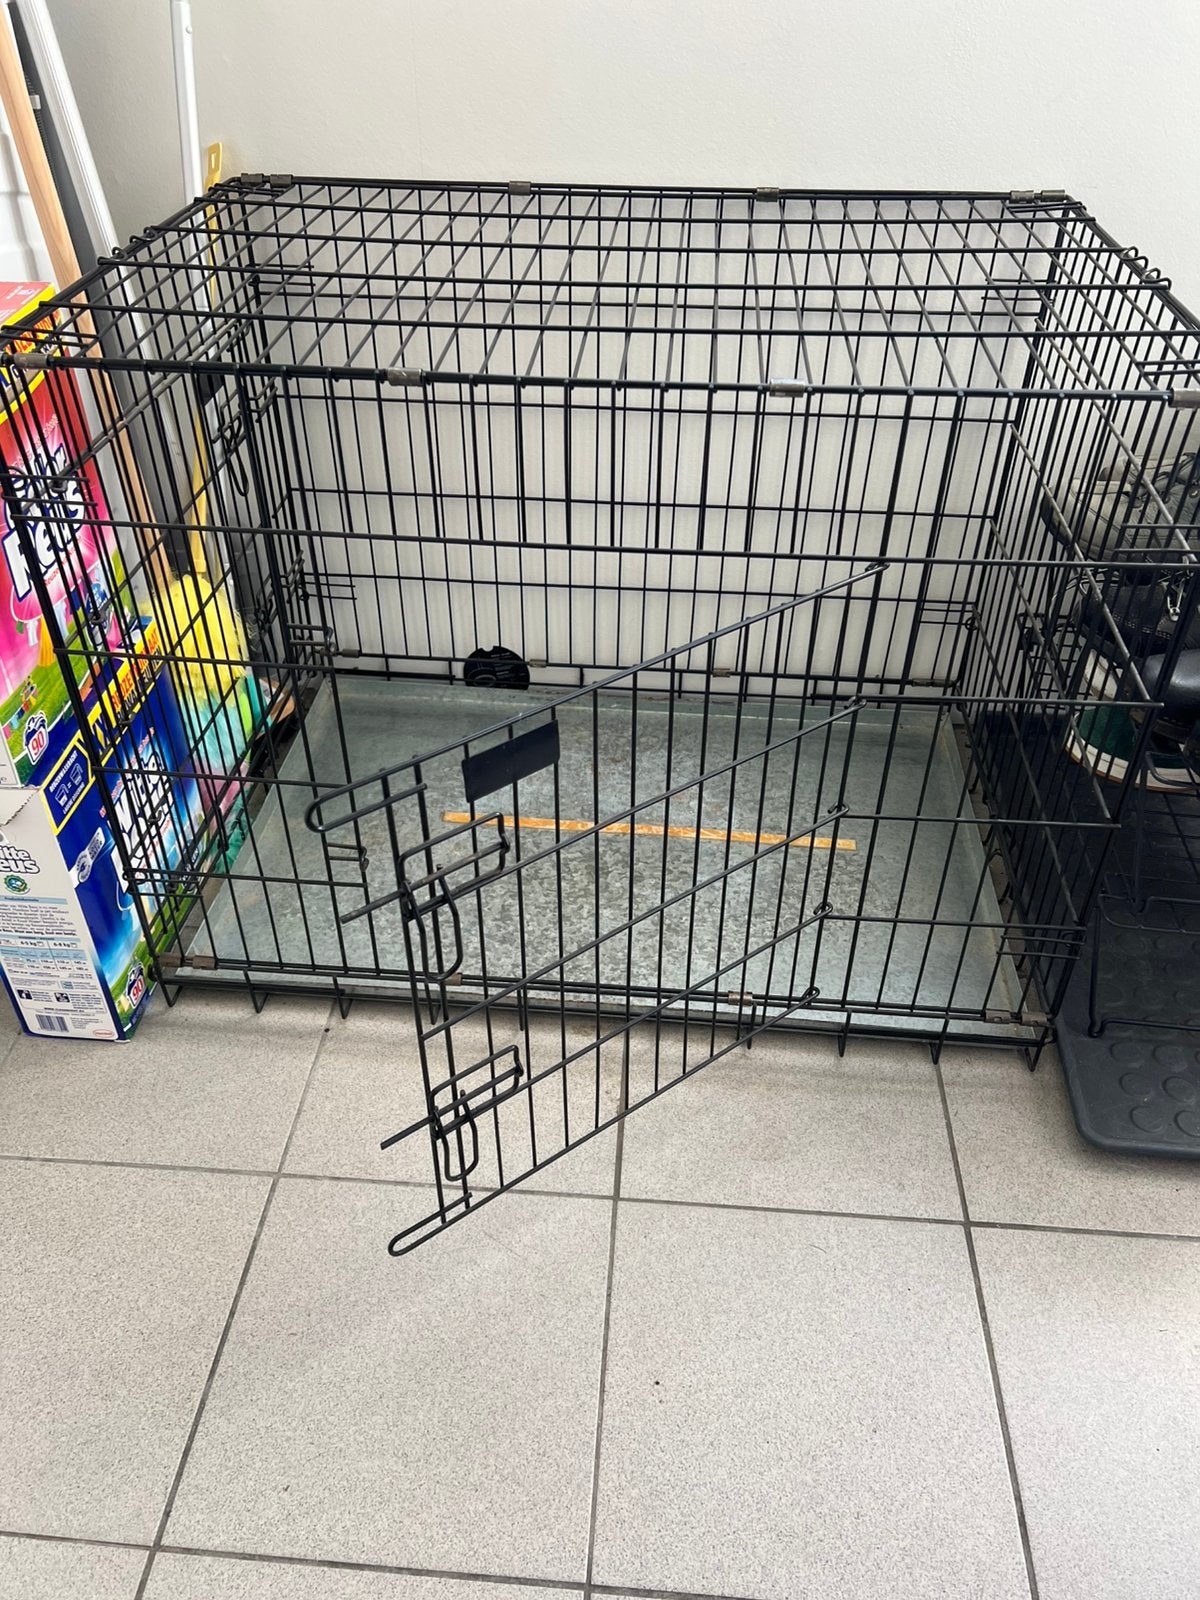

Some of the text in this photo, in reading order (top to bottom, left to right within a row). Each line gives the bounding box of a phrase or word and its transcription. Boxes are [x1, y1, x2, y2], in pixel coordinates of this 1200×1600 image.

[31, 730, 46, 757] 90
[0, 845, 32, 860] itte
[0, 859, 41, 874] eus
[133, 978, 144, 1000] 90
